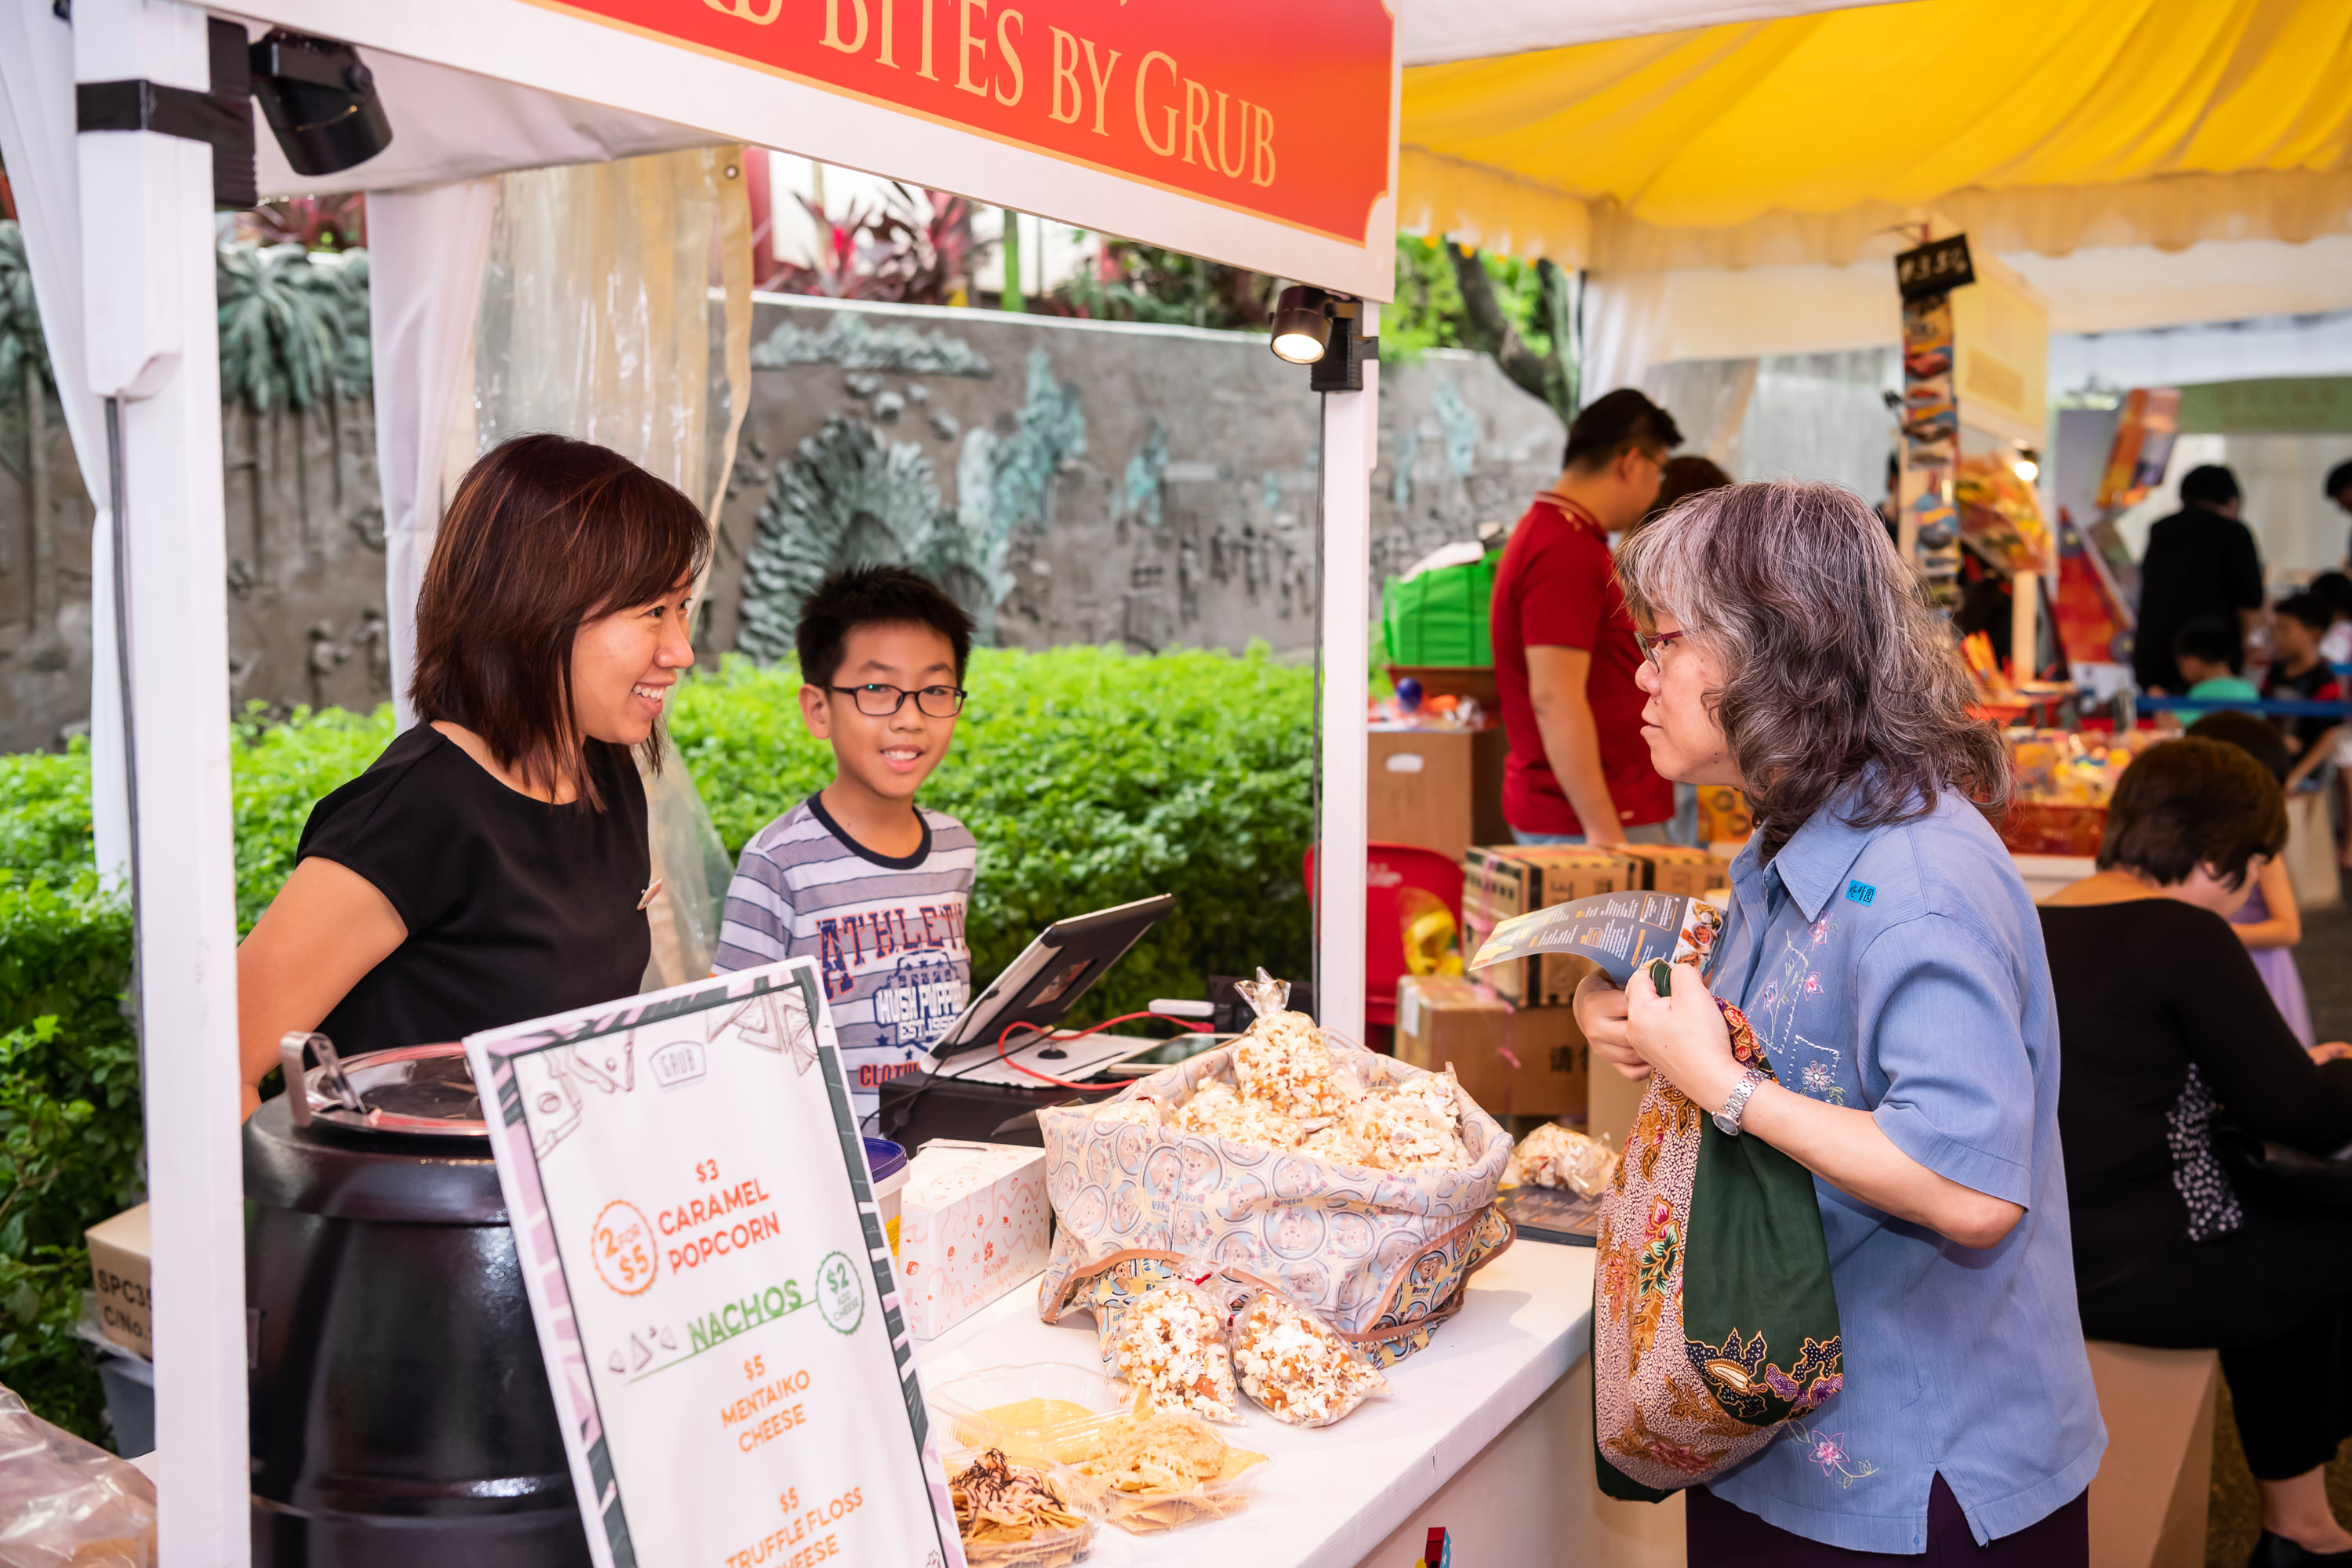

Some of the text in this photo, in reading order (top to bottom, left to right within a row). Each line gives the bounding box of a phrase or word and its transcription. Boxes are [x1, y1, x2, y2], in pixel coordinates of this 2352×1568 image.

[1048, 25, 1122, 137] BY
[1134, 50, 1276, 188] GRUB
[696, 1158, 719, 1184] $3
[659, 1178, 770, 1236] CARAMEL
[599, 1227, 618, 1258] 2
[619, 1243, 649, 1283] $5
[669, 1211, 780, 1275] POPCORN
[827, 1261, 850, 1294] $2
[688, 1278, 802, 1354] NACHOS
[744, 1355, 766, 1381] $5
[720, 1370, 810, 1428] MENTAIKO
[739, 1403, 807, 1452] CHEESE
[779, 1486, 799, 1514] $5
[726, 1486, 863, 1568] TRUFFLE FLOSS
